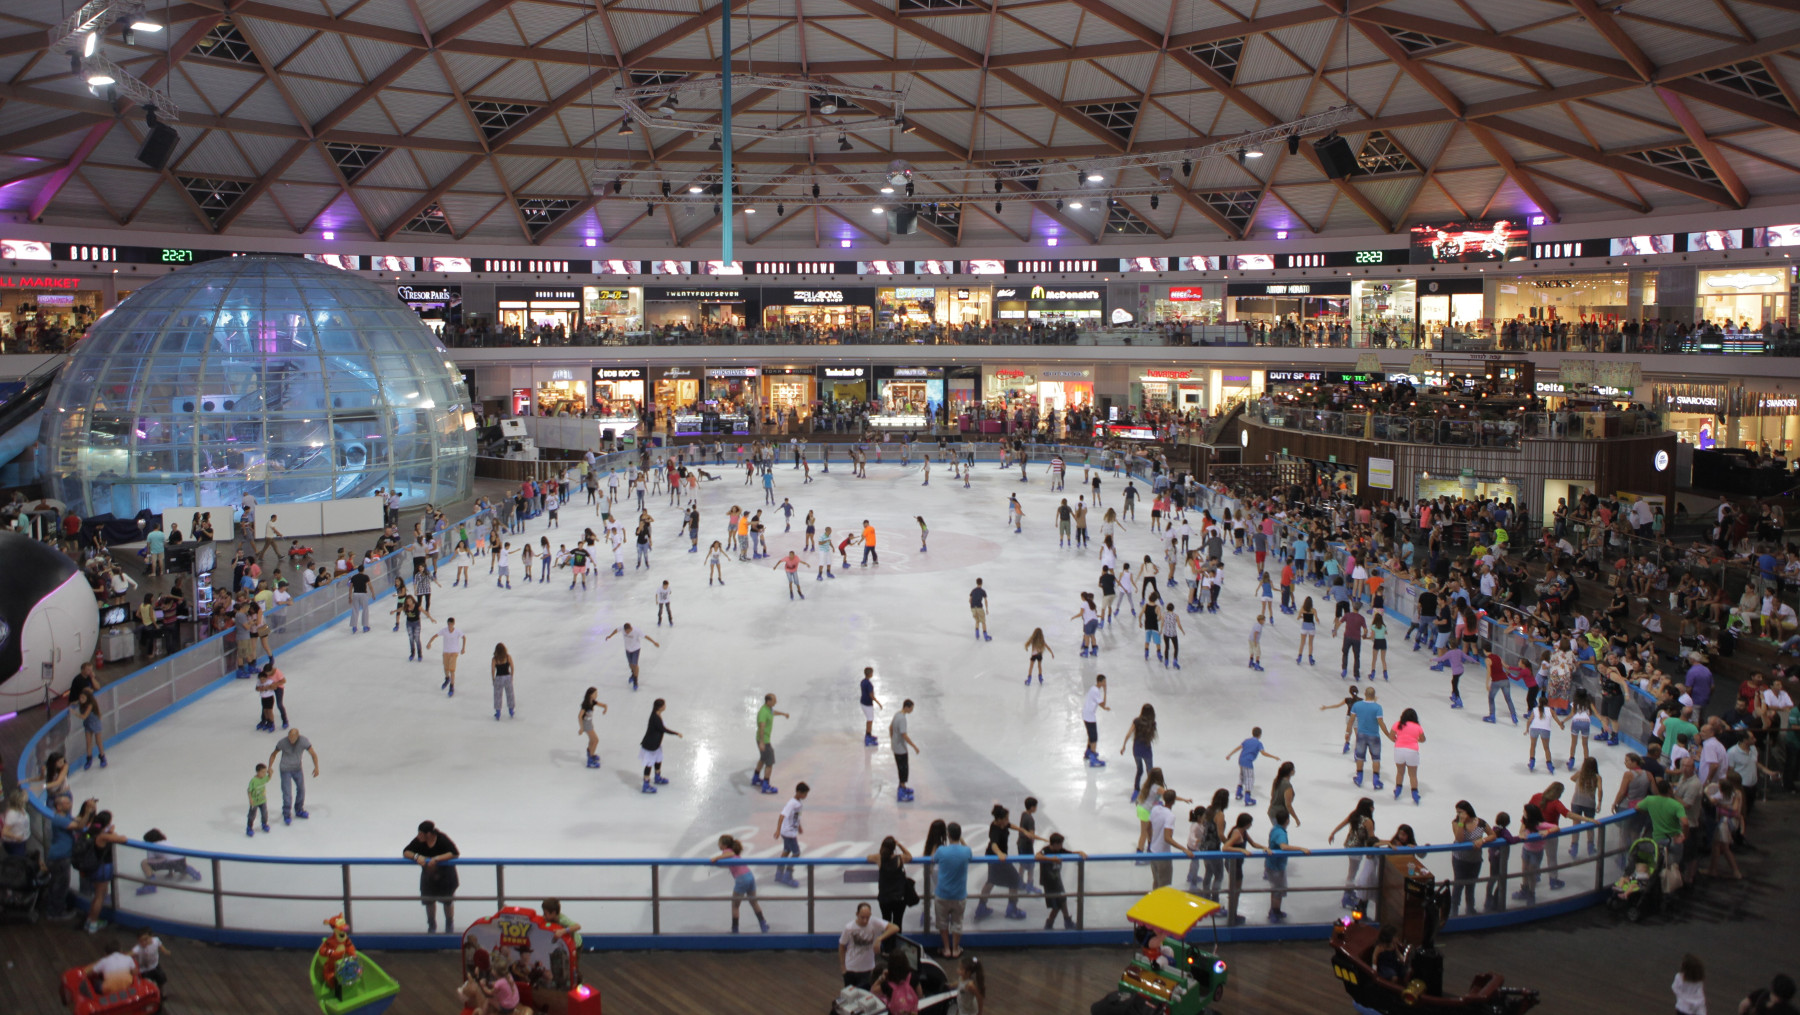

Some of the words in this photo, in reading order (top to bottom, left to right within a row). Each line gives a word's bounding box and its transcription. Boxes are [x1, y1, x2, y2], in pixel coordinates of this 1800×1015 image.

[70, 246, 116, 261] BOBBI
[162, 249, 192, 261] 22:27
[1535, 243, 1582, 258] BROWN
[1289, 255, 1325, 267] BOBBI
[1356, 251, 1382, 263] 22:23
[485, 260, 521, 272] BOBBI
[529, 260, 568, 272] BROWN
[756, 262, 790, 274] BOBBI
[797, 262, 834, 274] BROWN
[1018, 261, 1052, 272] BOBBI
[1060, 260, 1098, 272] BROWN
[20, 277, 80, 288] MARKET
[1536, 280, 1572, 288] SACK'S
[1046, 291, 1099, 299] McDonald's
[1270, 372, 1291, 380] DUTY
[1293, 372, 1321, 380] SPORT
[1536, 382, 1564, 392] Delta
[1677, 396, 1717, 406] SWAROVSKI
[1767, 399, 1797, 407] SWAROVSKI
[501, 921, 530, 937] TOY
